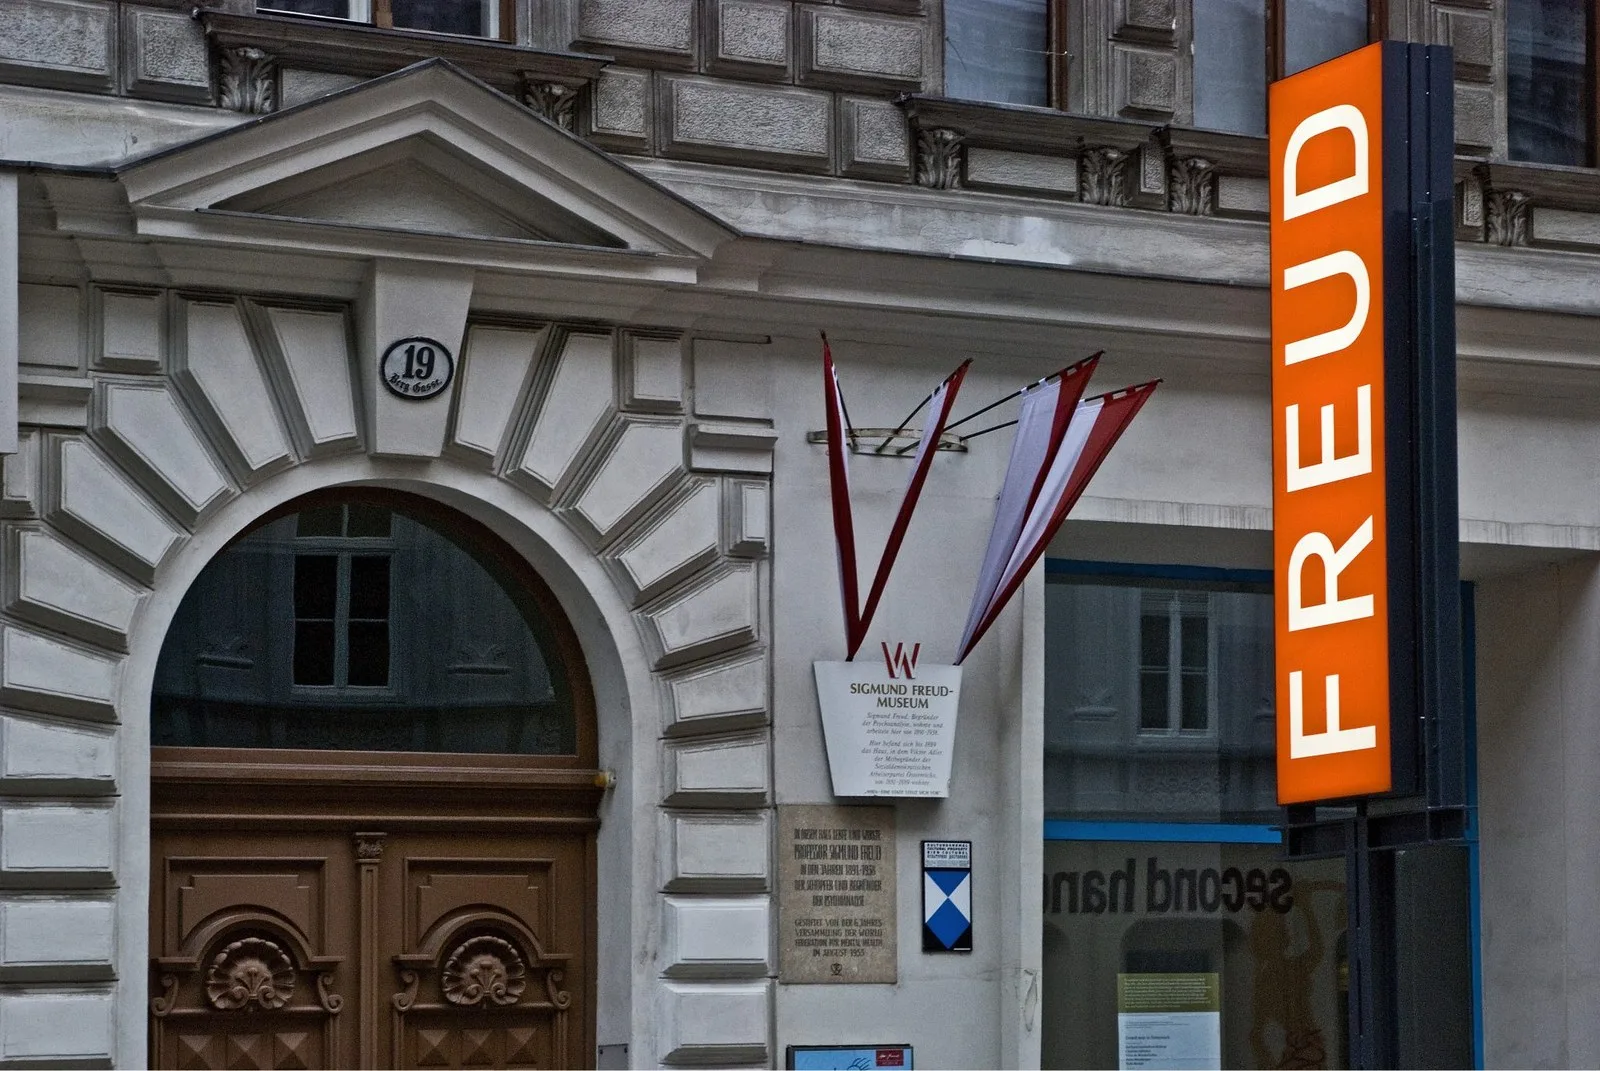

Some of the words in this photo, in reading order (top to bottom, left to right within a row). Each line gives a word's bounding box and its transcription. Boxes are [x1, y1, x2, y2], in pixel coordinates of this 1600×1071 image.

[402, 345, 435, 379] 19
[389, 373, 410, 393] Berg
[1283, 103, 1377, 760] FREUD
[881, 641, 921, 680] W
[850, 683, 908, 695] SIGMUND
[912, 684, 954, 697] FREUD-
[876, 697, 929, 709] MUSEUM
[866, 712, 891, 720] Sigmund
[911, 713, 939, 721] Begründer
[794, 844, 828, 860] PROFESSOR
[829, 844, 859, 860] SIGMUND
[860, 844, 882, 861] FREUD
[808, 864, 819, 875] DEN
[820, 864, 844, 875] JAHREN
[834, 880, 848, 891] UND
[812, 895, 823, 906] DER
[825, 918, 839, 927] VON
[841, 918, 853, 927] DER
[795, 928, 842, 937] VERSAMMLUNG
[845, 929, 857, 937] DER
[858, 928, 883, 937] WORLD
[823, 948, 847, 957] AUGUST
